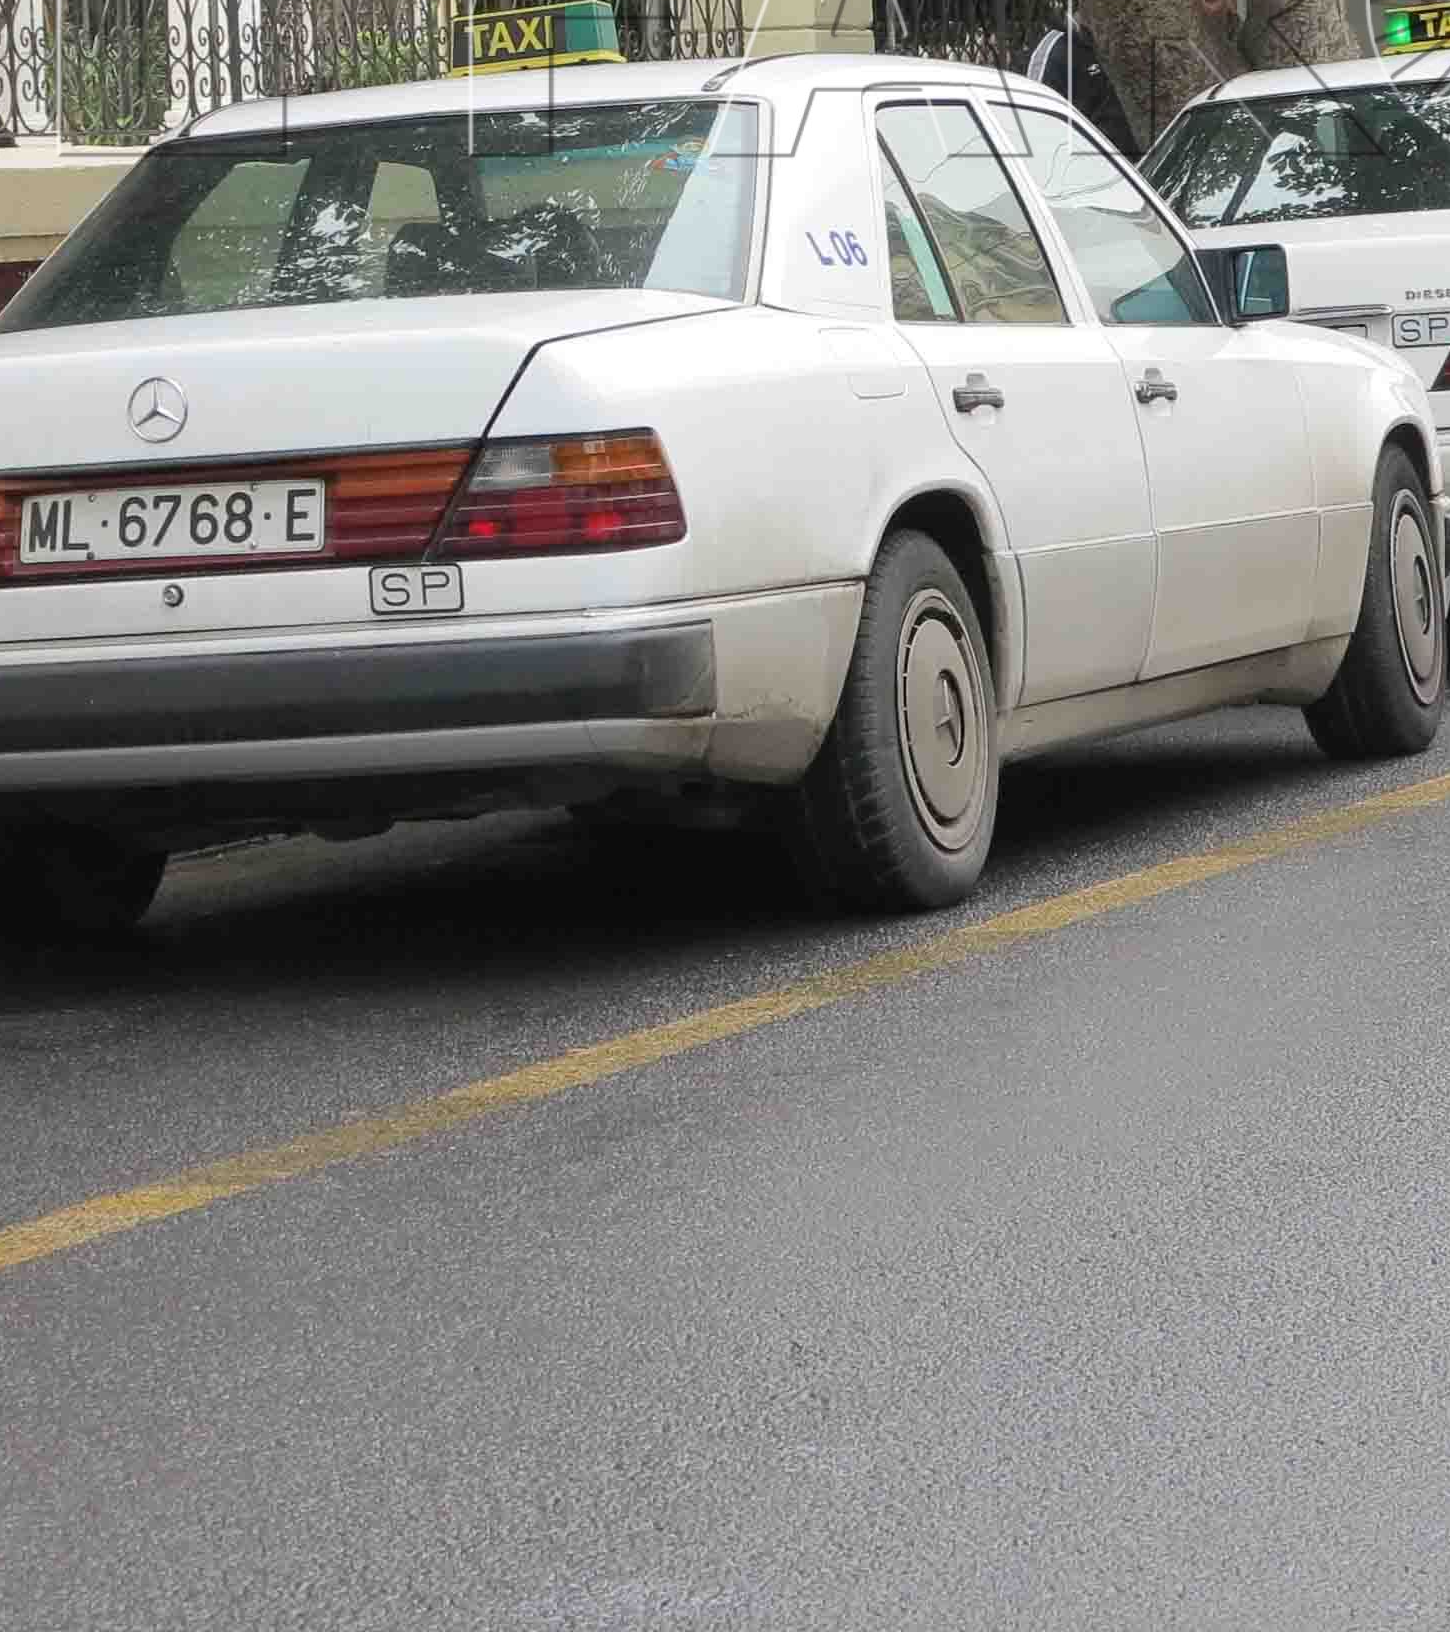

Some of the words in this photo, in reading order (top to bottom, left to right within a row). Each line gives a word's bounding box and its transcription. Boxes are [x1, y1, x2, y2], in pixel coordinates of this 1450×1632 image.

[465, 15, 554, 58] TAXI
[1400, 317, 1449, 343] SP
[380, 574, 452, 607] SP
